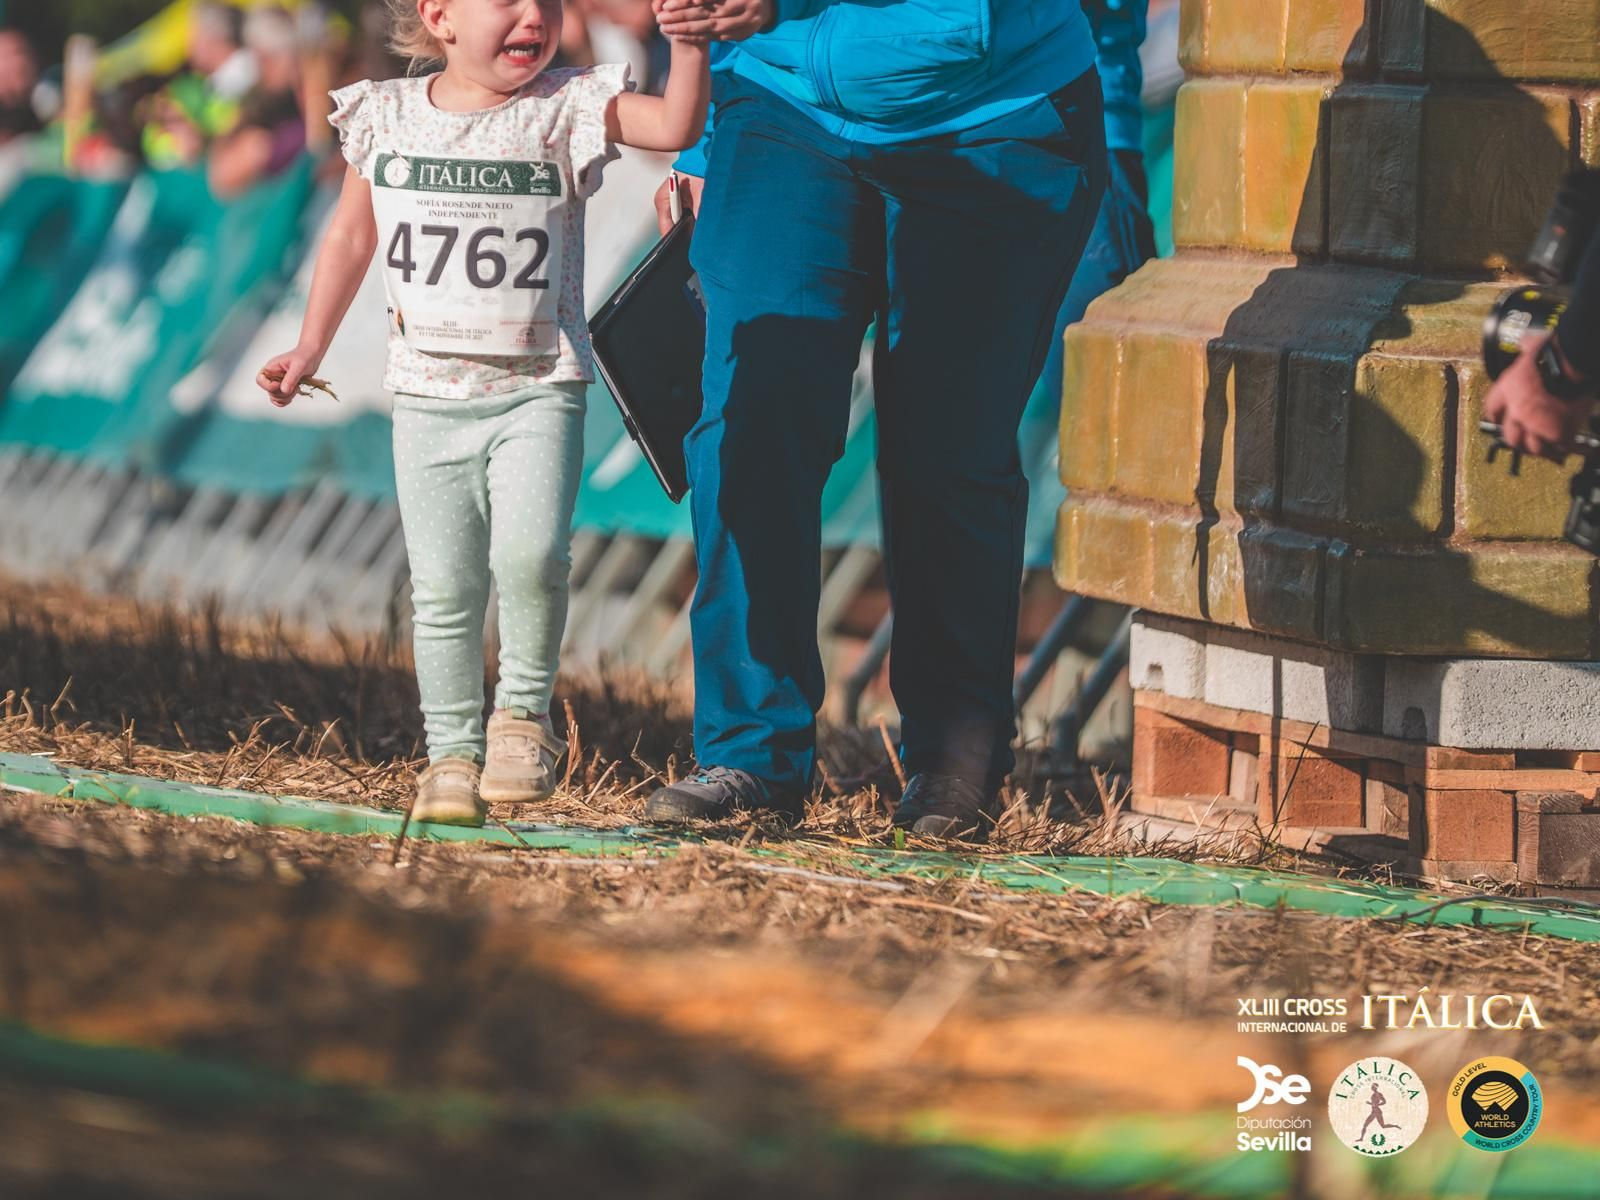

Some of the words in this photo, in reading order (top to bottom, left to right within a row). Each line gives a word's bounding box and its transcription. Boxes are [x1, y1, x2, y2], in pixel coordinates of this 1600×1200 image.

[418, 161, 515, 188] ITÁLICA
[428, 209, 498, 220] INDEPENDIENTE
[442, 200, 484, 209] ROSENDE
[485, 202, 513, 210] NIETO
[386, 222, 550, 290] 4762
